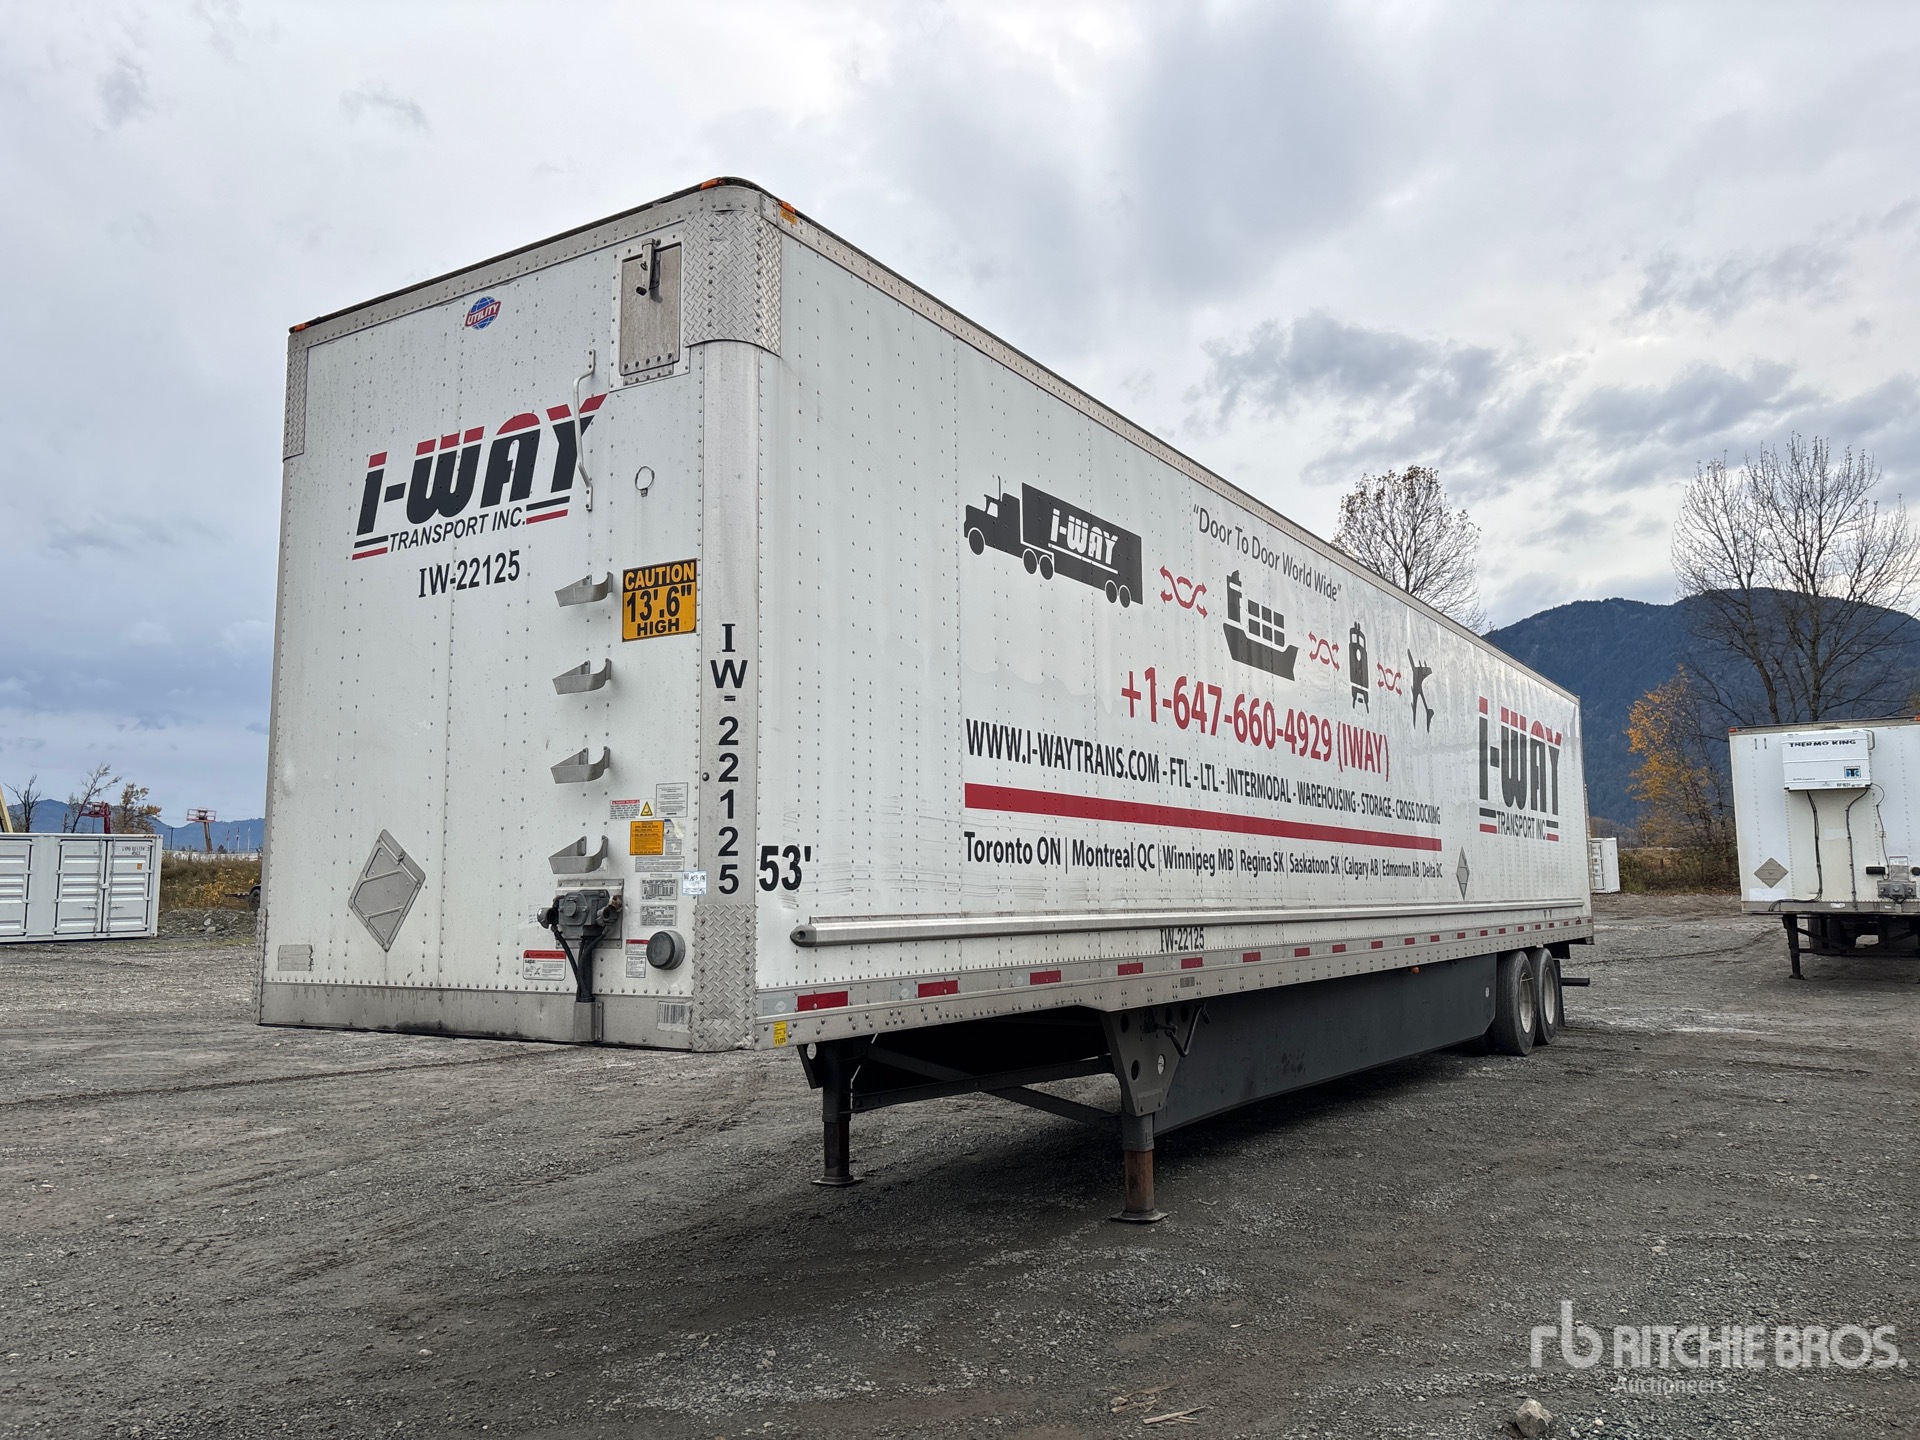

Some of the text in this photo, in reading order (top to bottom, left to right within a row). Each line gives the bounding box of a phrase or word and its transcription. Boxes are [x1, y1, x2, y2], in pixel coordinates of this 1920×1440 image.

[467, 303, 499, 325] UTILITY
[389, 506, 526, 551] TRANSPORT INC.
[419, 550, 521, 599] IW-22125
[625, 562, 695, 590] CAUTION
[1234, 525, 1249, 555] To
[1251, 535, 1280, 571] Door
[1282, 552, 1312, 588] World
[637, 618, 680, 636] HIGH
[1121, 666, 1390, 782] +1-647-660-4929 (IWAY)
[1789, 740, 1829, 748] THERMO
[966, 718, 1160, 784] WWW.I-WAYTRANS.COM
[1169, 757, 1191, 788] FTL
[1200, 762, 1219, 793] LTL
[1226, 767, 1291, 803] INTERMODAL
[1297, 781, 1357, 813] WAREHOUSING
[1361, 793, 1392, 818] STORAGE
[1396, 800, 1415, 822] CROSS
[1415, 802, 1441, 825] DOCKING
[1496, 810, 1535, 839] TRANSPORT
[758, 844, 812, 892] 53'
[964, 831, 1033, 865] Toronto
[1037, 836, 1061, 866] ON
[1072, 839, 1134, 868] Montreal
[1137, 843, 1156, 872] QC
[1162, 844, 1215, 877] Winnipeg
[1218, 848, 1234, 871] MB
[1240, 850, 1271, 878] Regina
[1273, 851, 1285, 873] SK
[1290, 853, 1330, 875] Saskatoon
[1331, 856, 1341, 875] SK
[1344, 856, 1369, 880] Calgary
[1370, 858, 1379, 876] AB
[1382, 860, 1412, 878] Edmonton
[1412, 861, 1420, 878] AB
[1422, 861, 1435, 878] Delta
[1436, 863, 1443, 879] BC
[1160, 927, 1205, 953] IW-22125
